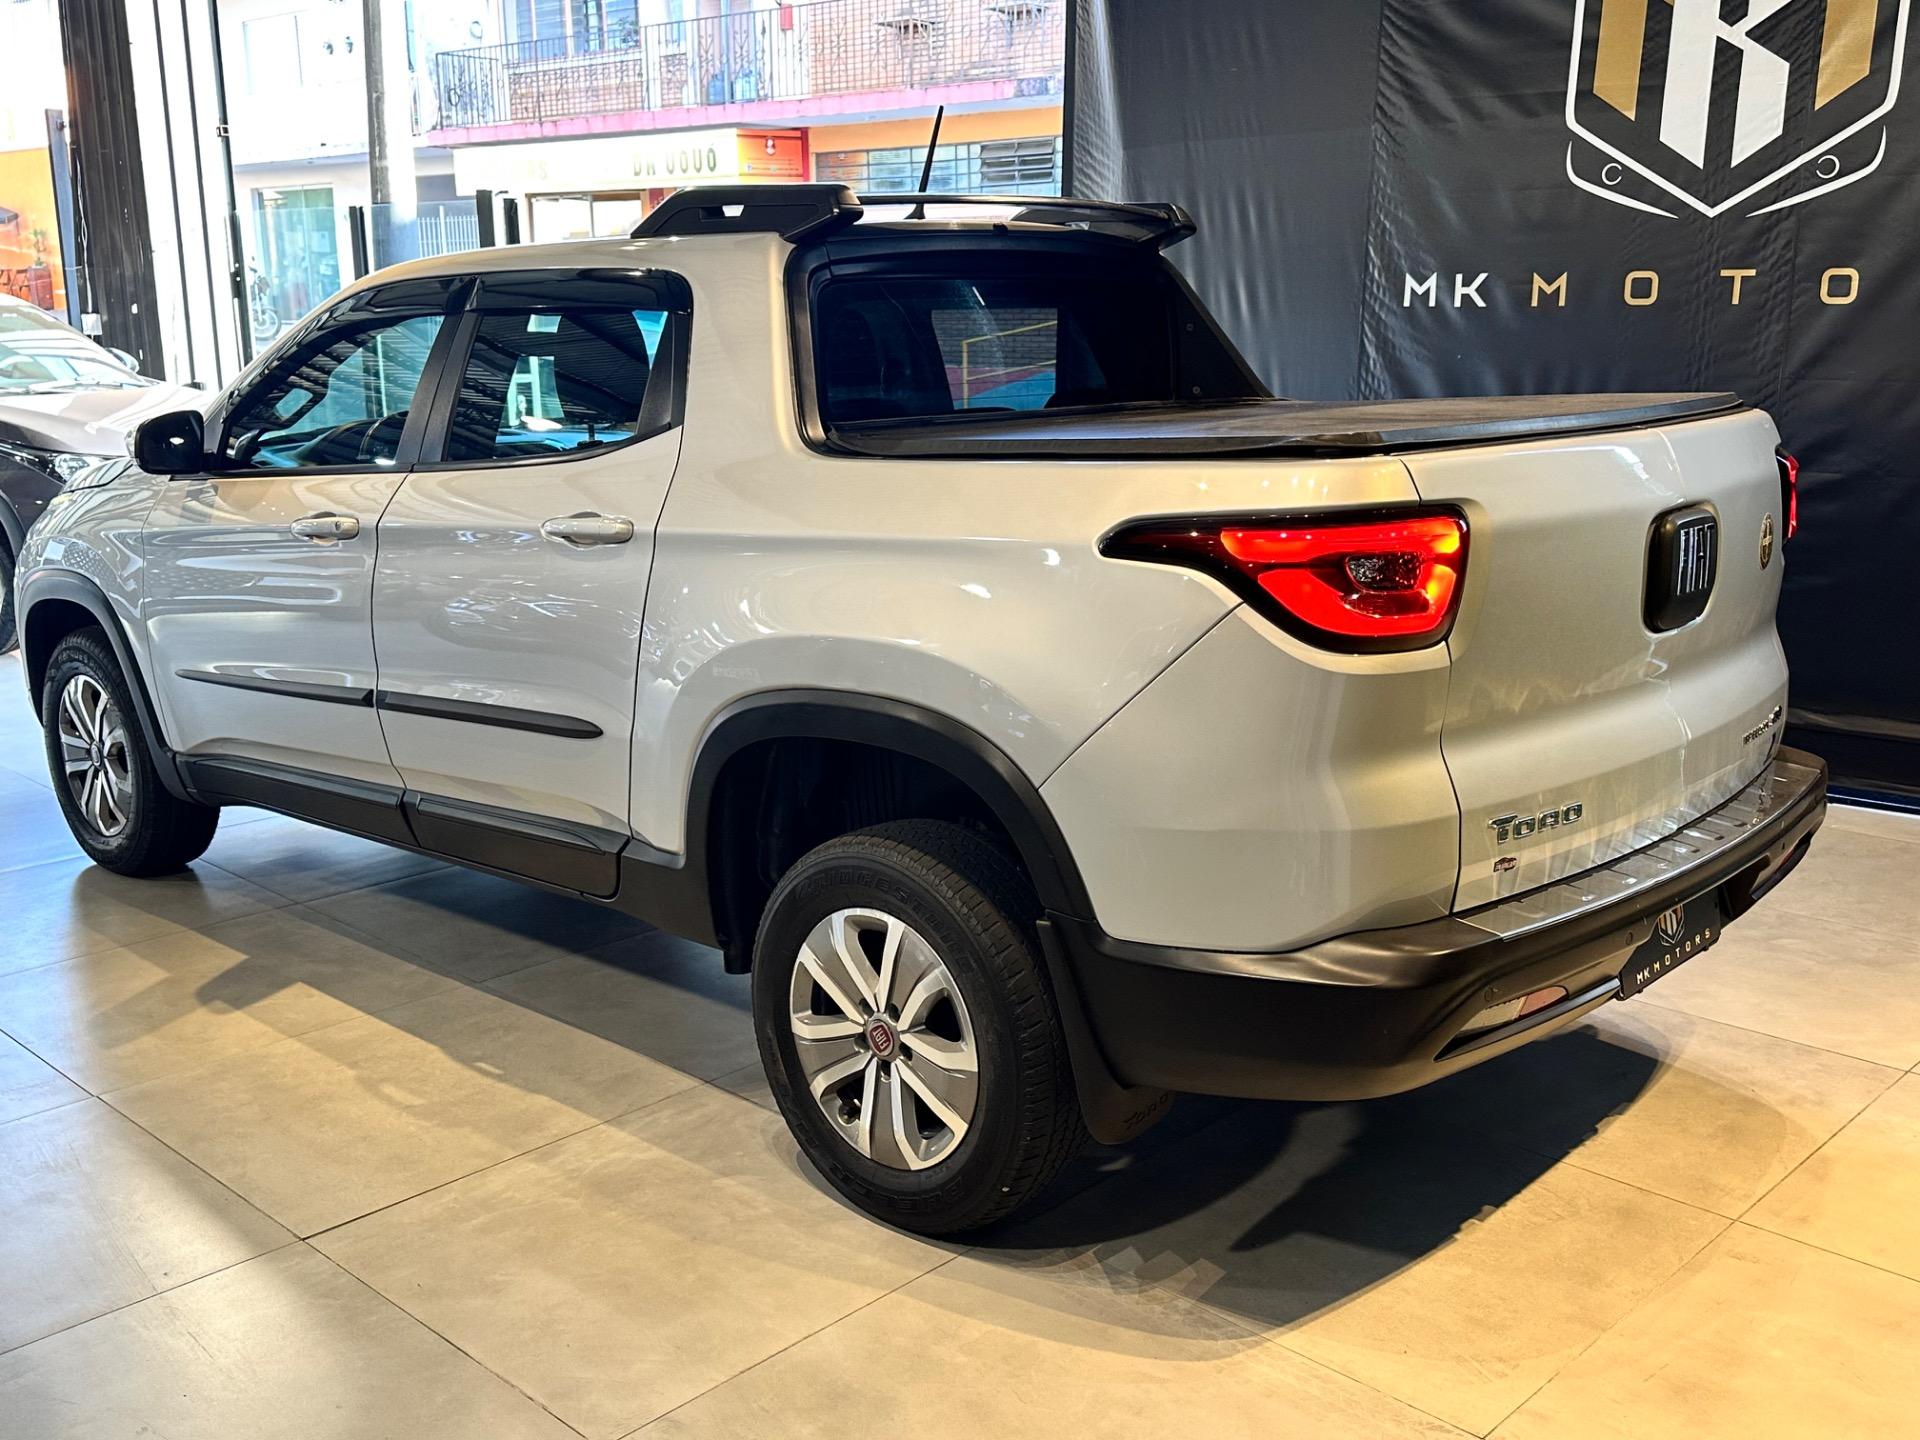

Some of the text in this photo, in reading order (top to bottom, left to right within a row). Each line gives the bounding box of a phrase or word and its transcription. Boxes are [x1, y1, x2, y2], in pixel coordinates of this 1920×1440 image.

[1402, 267, 1860, 308] MK MOTO
[1676, 522, 1716, 595] FIAT
[1636, 928, 1711, 985] MK MOTORS
[871, 1026, 890, 1050] FIAT
